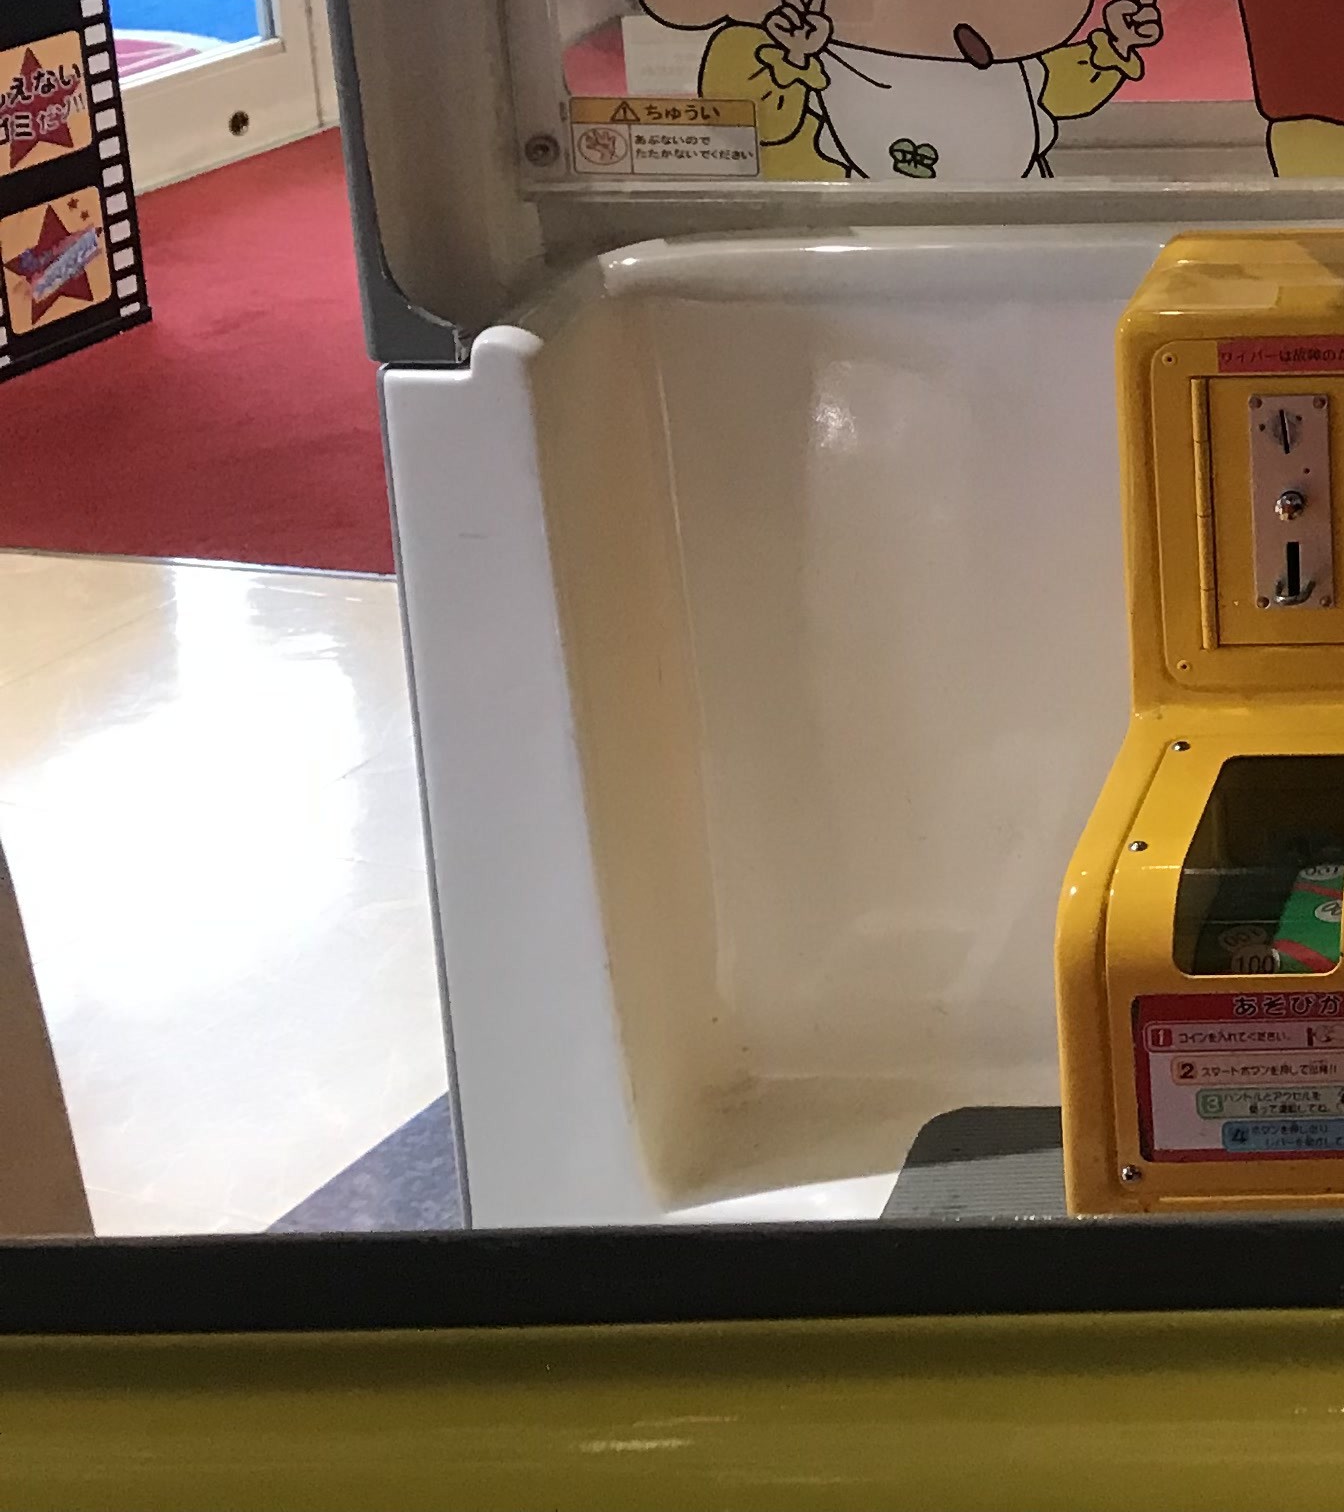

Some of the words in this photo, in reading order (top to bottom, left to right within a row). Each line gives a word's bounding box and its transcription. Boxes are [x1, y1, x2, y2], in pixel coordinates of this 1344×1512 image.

[645, 105, 720, 120] ちゅうい
[1180, 1063, 1194, 1078] 2
